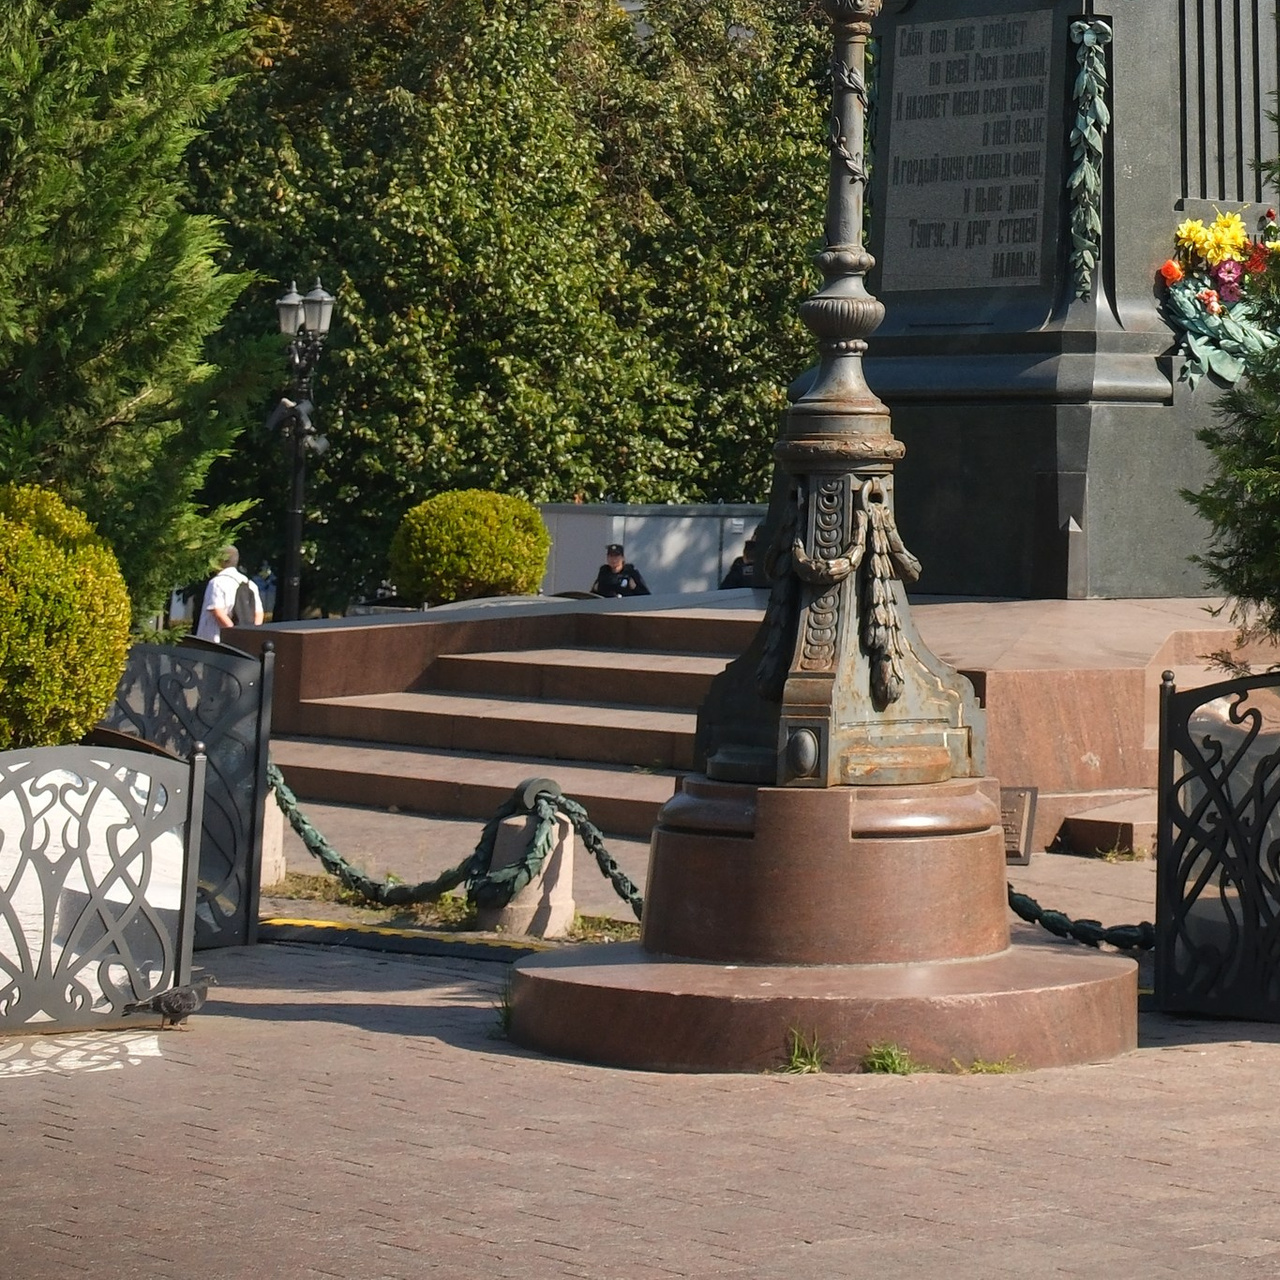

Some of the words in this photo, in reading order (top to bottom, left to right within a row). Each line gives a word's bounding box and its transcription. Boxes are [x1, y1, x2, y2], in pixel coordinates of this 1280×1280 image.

[929, 29, 947, 54] ОБО
[954, 26, 975, 52] МНЕ
[929, 61, 941, 86] ПО
[945, 53, 969, 84] ВСЕЙ
[896, 92, 903, 121] И
[905, 93, 950, 120] НАЗОВЕТ
[952, 90, 980, 116] МЕНЯ
[983, 87, 1007, 114] ВСЯК
[1010, 78, 1045, 113] СУЩИЙ
[982, 121, 989, 146] В
[992, 115, 1012, 146] НЕЙ
[893, 155, 900, 185] И
[901, 152, 939, 187] ГОРДЫЙ
[940, 155, 965, 182] ВНУК
[963, 187, 971, 214] И
[975, 186, 1002, 212] НЫНЕ
[1007, 179, 1039, 214] ДИКИЙ
[952, 221, 959, 247] И
[965, 220, 991, 249] ДРУГ
[997, 212, 1038, 244] СТЕПЕЙ
